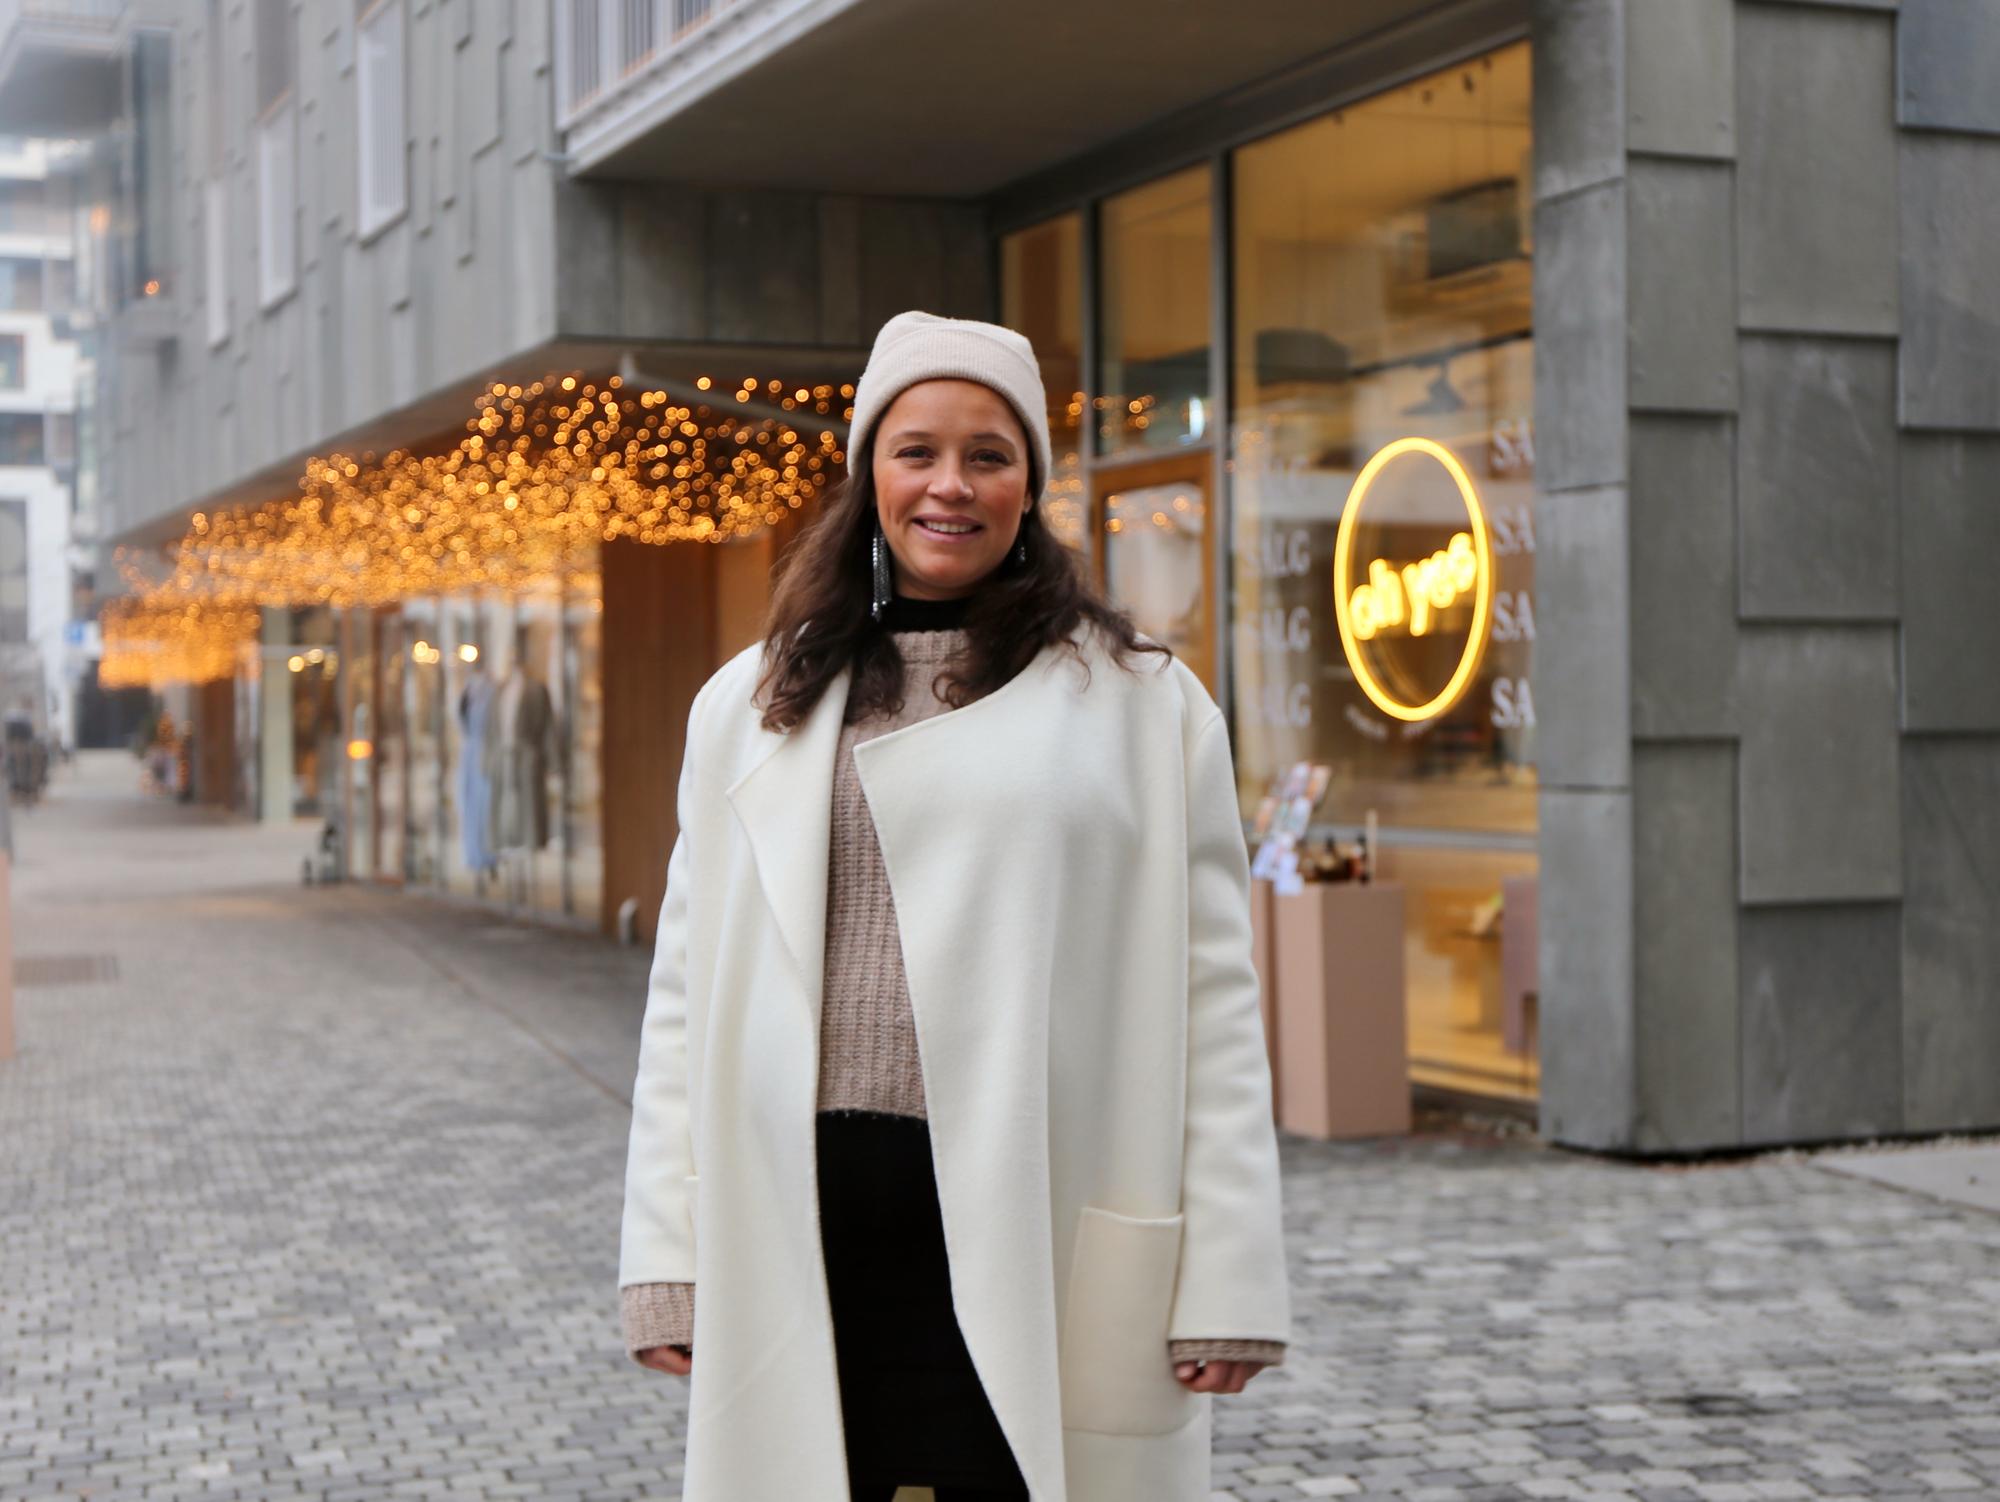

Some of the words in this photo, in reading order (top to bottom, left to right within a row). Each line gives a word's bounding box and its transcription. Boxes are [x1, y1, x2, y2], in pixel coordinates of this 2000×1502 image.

[1491, 418, 1536, 469] SA
[1491, 503, 1536, 555] SA
[1491, 590, 1537, 642] SA
[1489, 676, 1537, 729] SA
